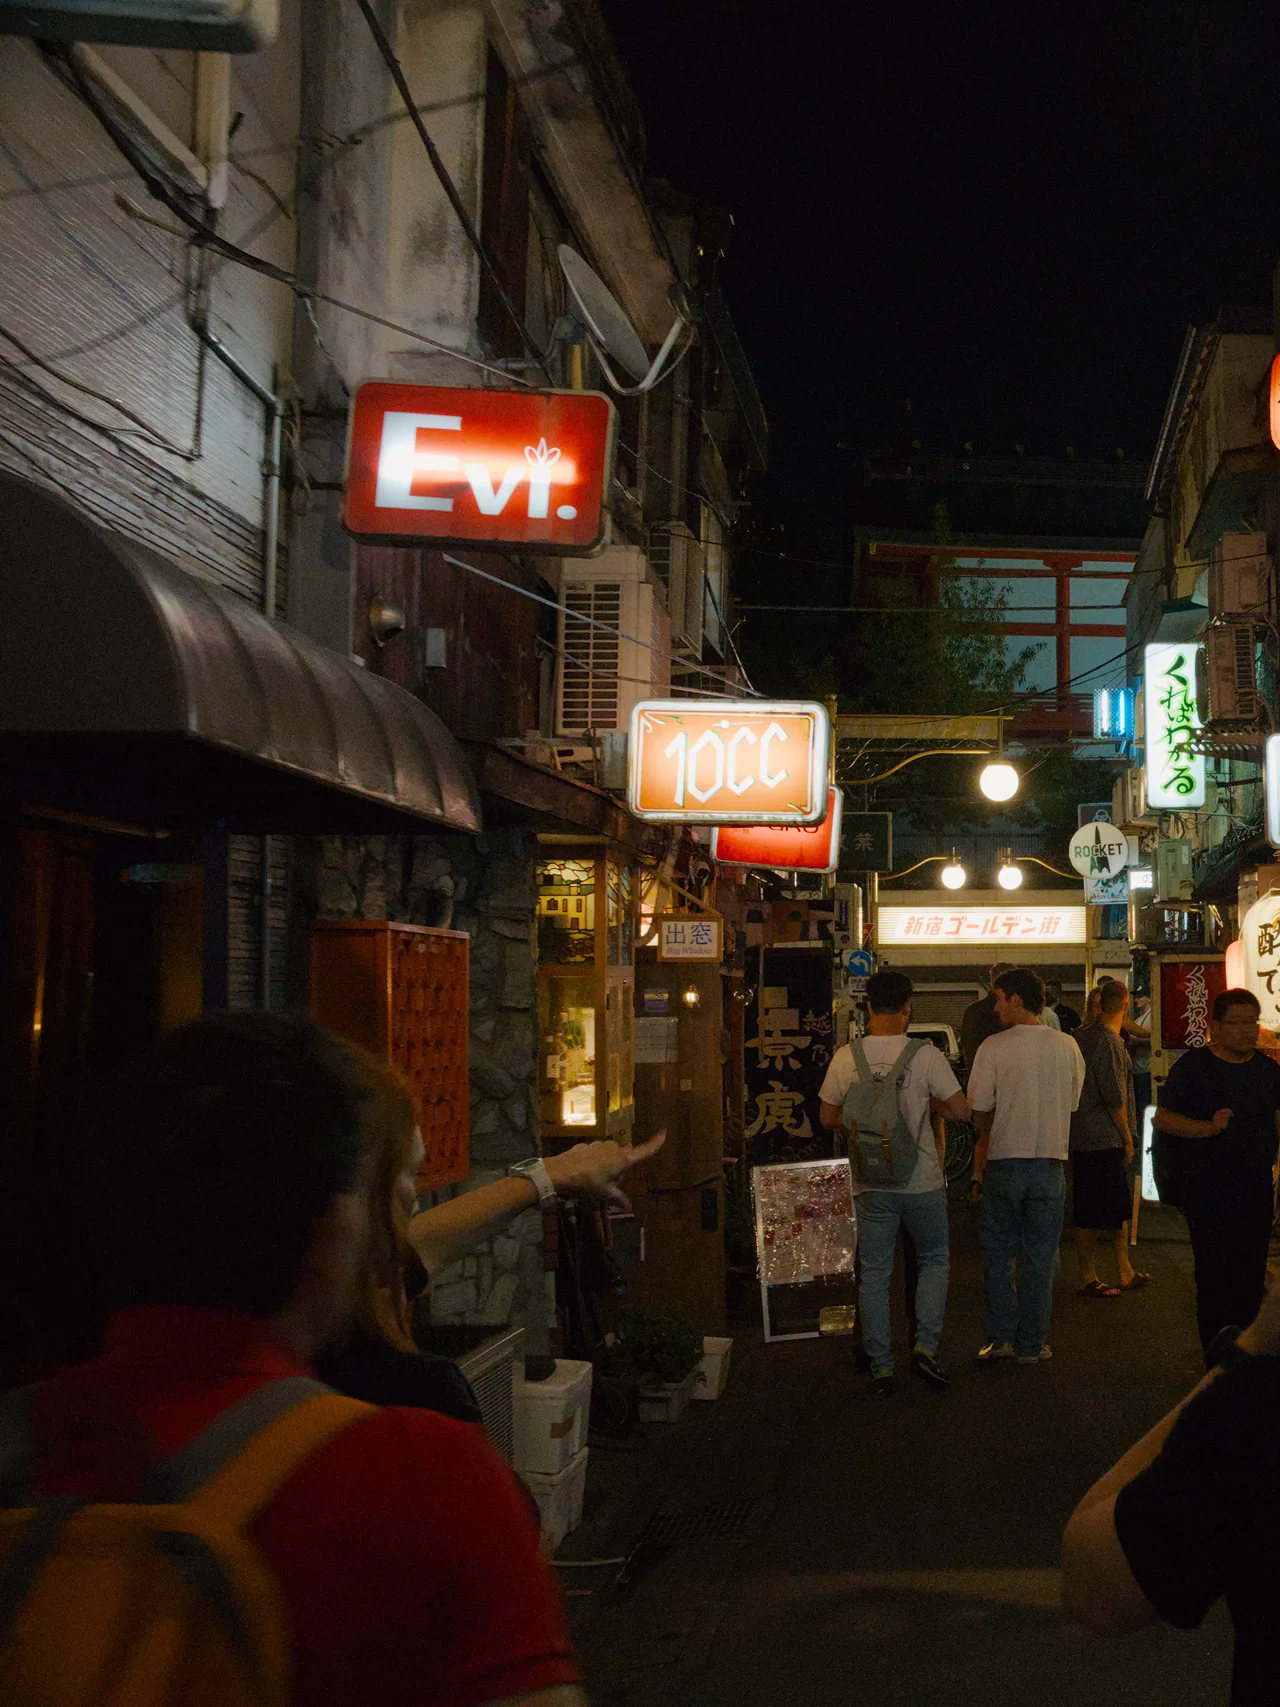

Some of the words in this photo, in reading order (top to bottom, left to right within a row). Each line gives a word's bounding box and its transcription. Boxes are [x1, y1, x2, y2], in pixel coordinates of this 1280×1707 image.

[1074, 843, 1123, 858] ROCKET
[666, 922, 712, 945] 出窓
[903, 915, 1062, 936] 新宿ゴールデン街
